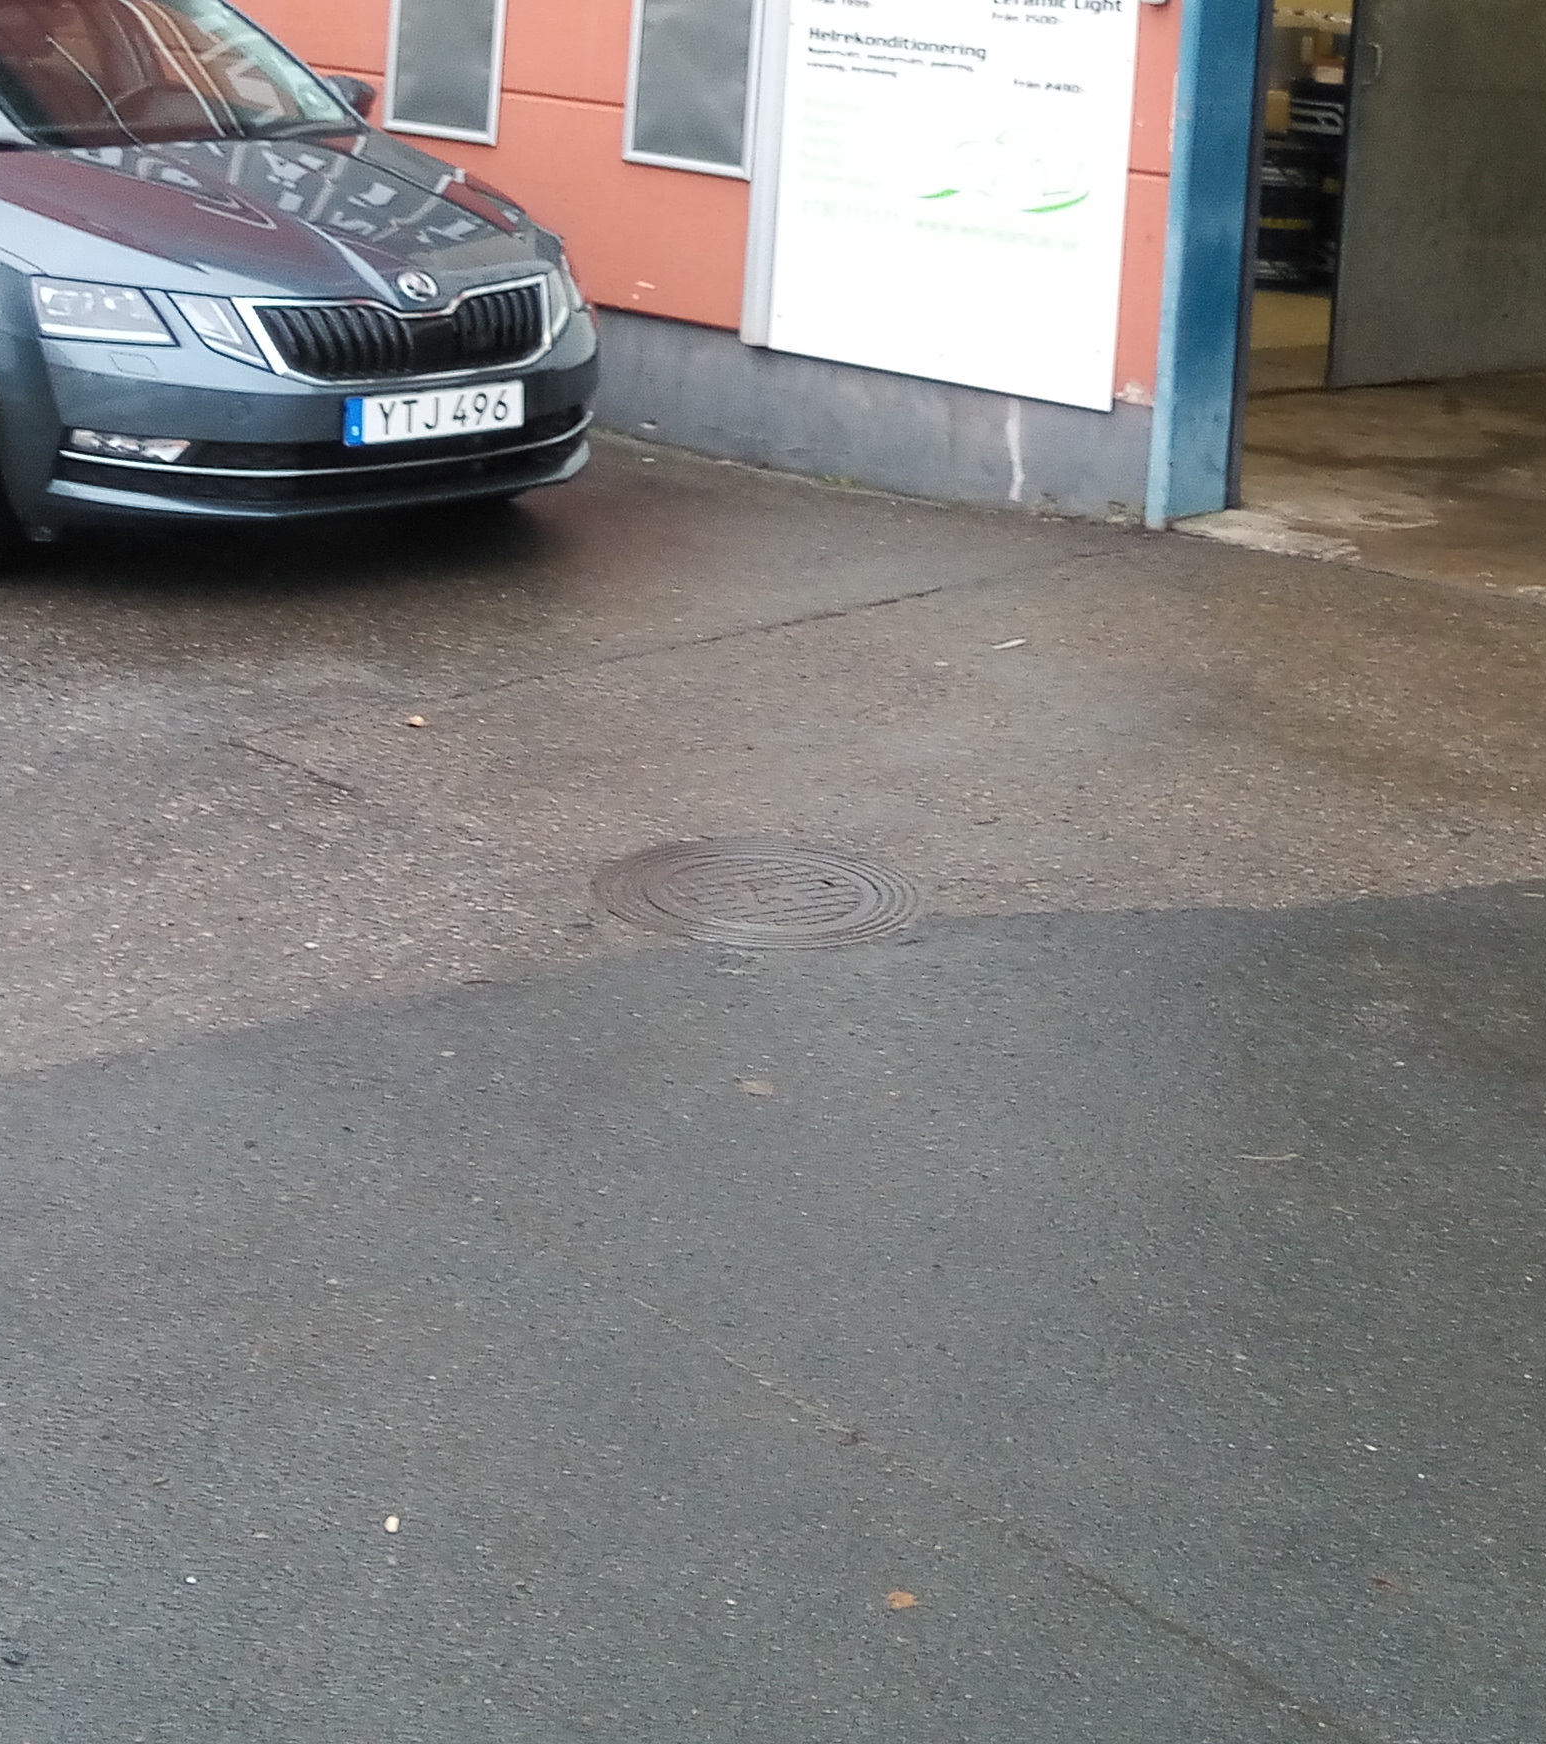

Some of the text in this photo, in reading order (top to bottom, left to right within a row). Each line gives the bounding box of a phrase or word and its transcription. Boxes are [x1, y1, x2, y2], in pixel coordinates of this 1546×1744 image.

[808, 27, 987, 61] Helrekonditionering
[377, 396, 440, 436] YTJ
[452, 389, 509, 427] 496
